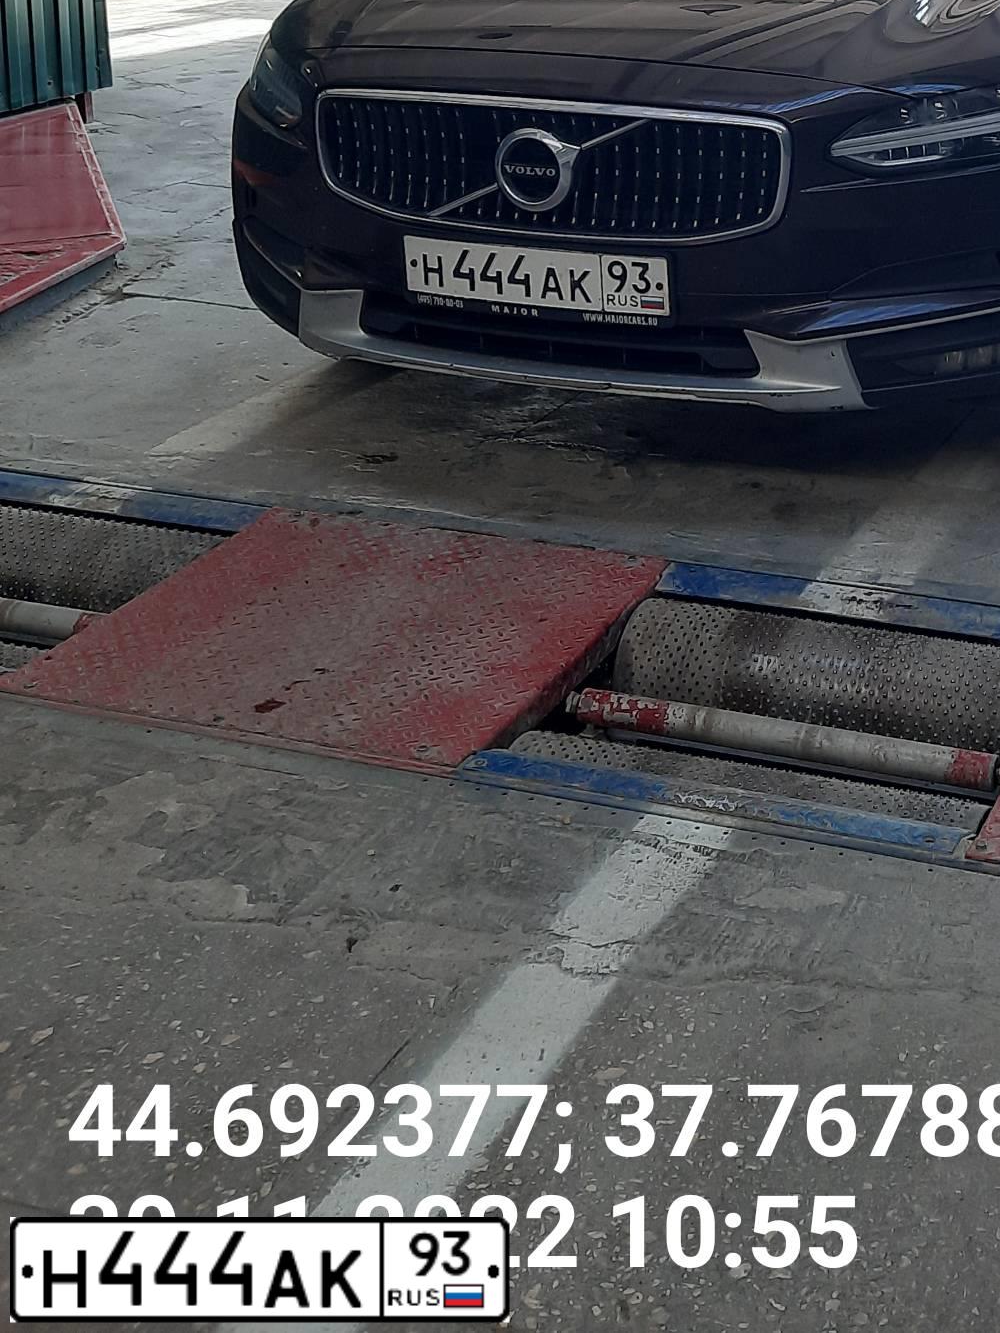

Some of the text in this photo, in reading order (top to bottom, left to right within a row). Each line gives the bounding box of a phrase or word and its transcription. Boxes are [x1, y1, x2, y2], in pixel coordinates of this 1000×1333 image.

[503, 164, 556, 177] VOLVO
[607, 260, 652, 294] 93
[606, 293, 639, 308] RUS
[491, 304, 539, 317] MAJOR
